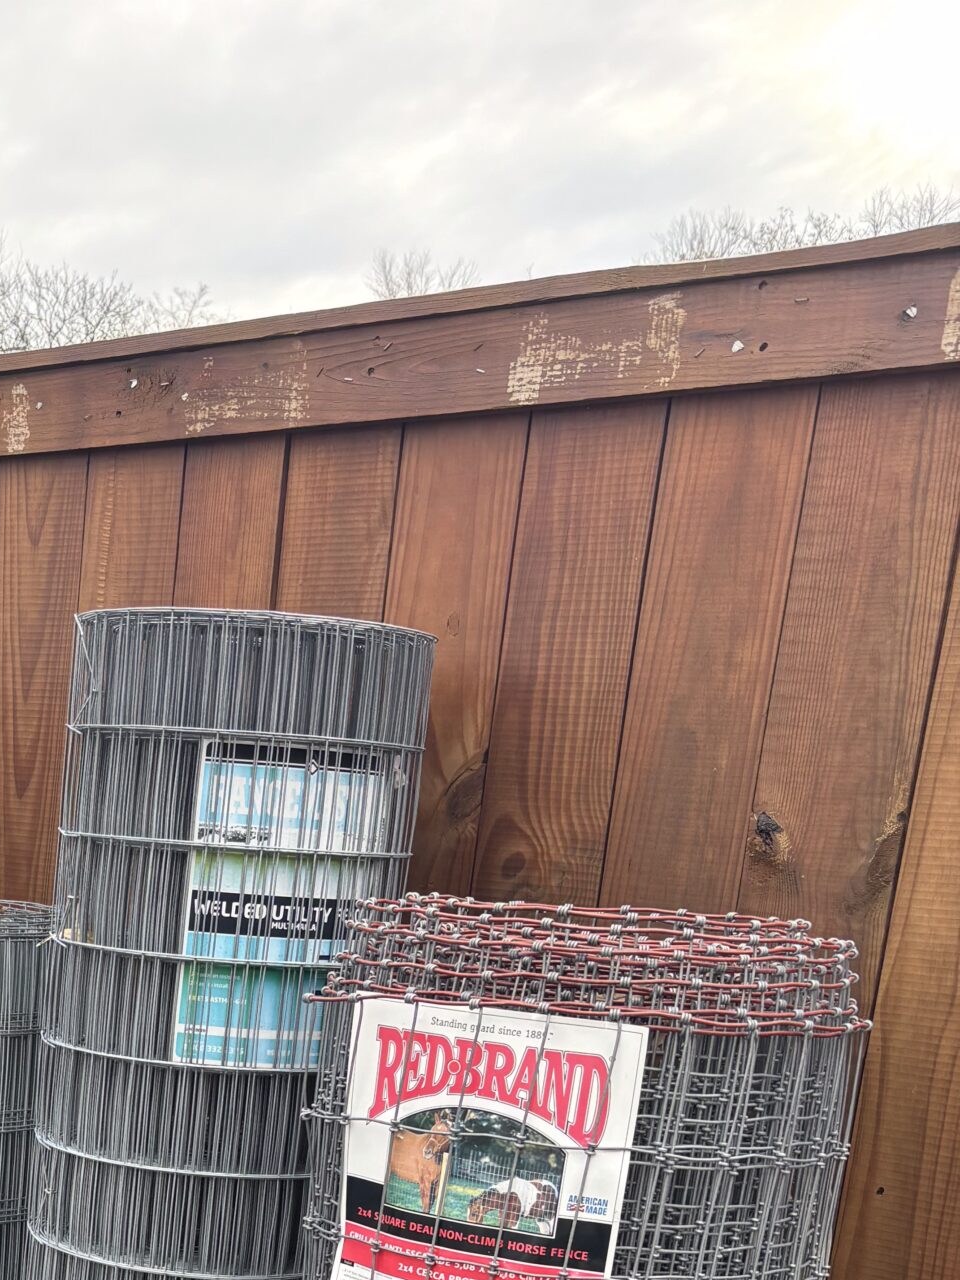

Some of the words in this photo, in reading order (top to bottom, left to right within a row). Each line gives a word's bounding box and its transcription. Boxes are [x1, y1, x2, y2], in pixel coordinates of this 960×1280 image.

[430, 1016, 468, 1031] Standing
[470, 1023, 496, 1034] gard
[498, 1026, 522, 1037] since
[585, 1206, 608, 1216] MADE
[357, 1206, 372, 1218] 2x4
[409, 1222, 436, 1236] DEAL
[507, 1240, 547, 1256] HORSE
[550, 1247, 589, 1262] FENCE
[397, 1262, 414, 1275] 2x4
[416, 1267, 445, 1280] CERCA
